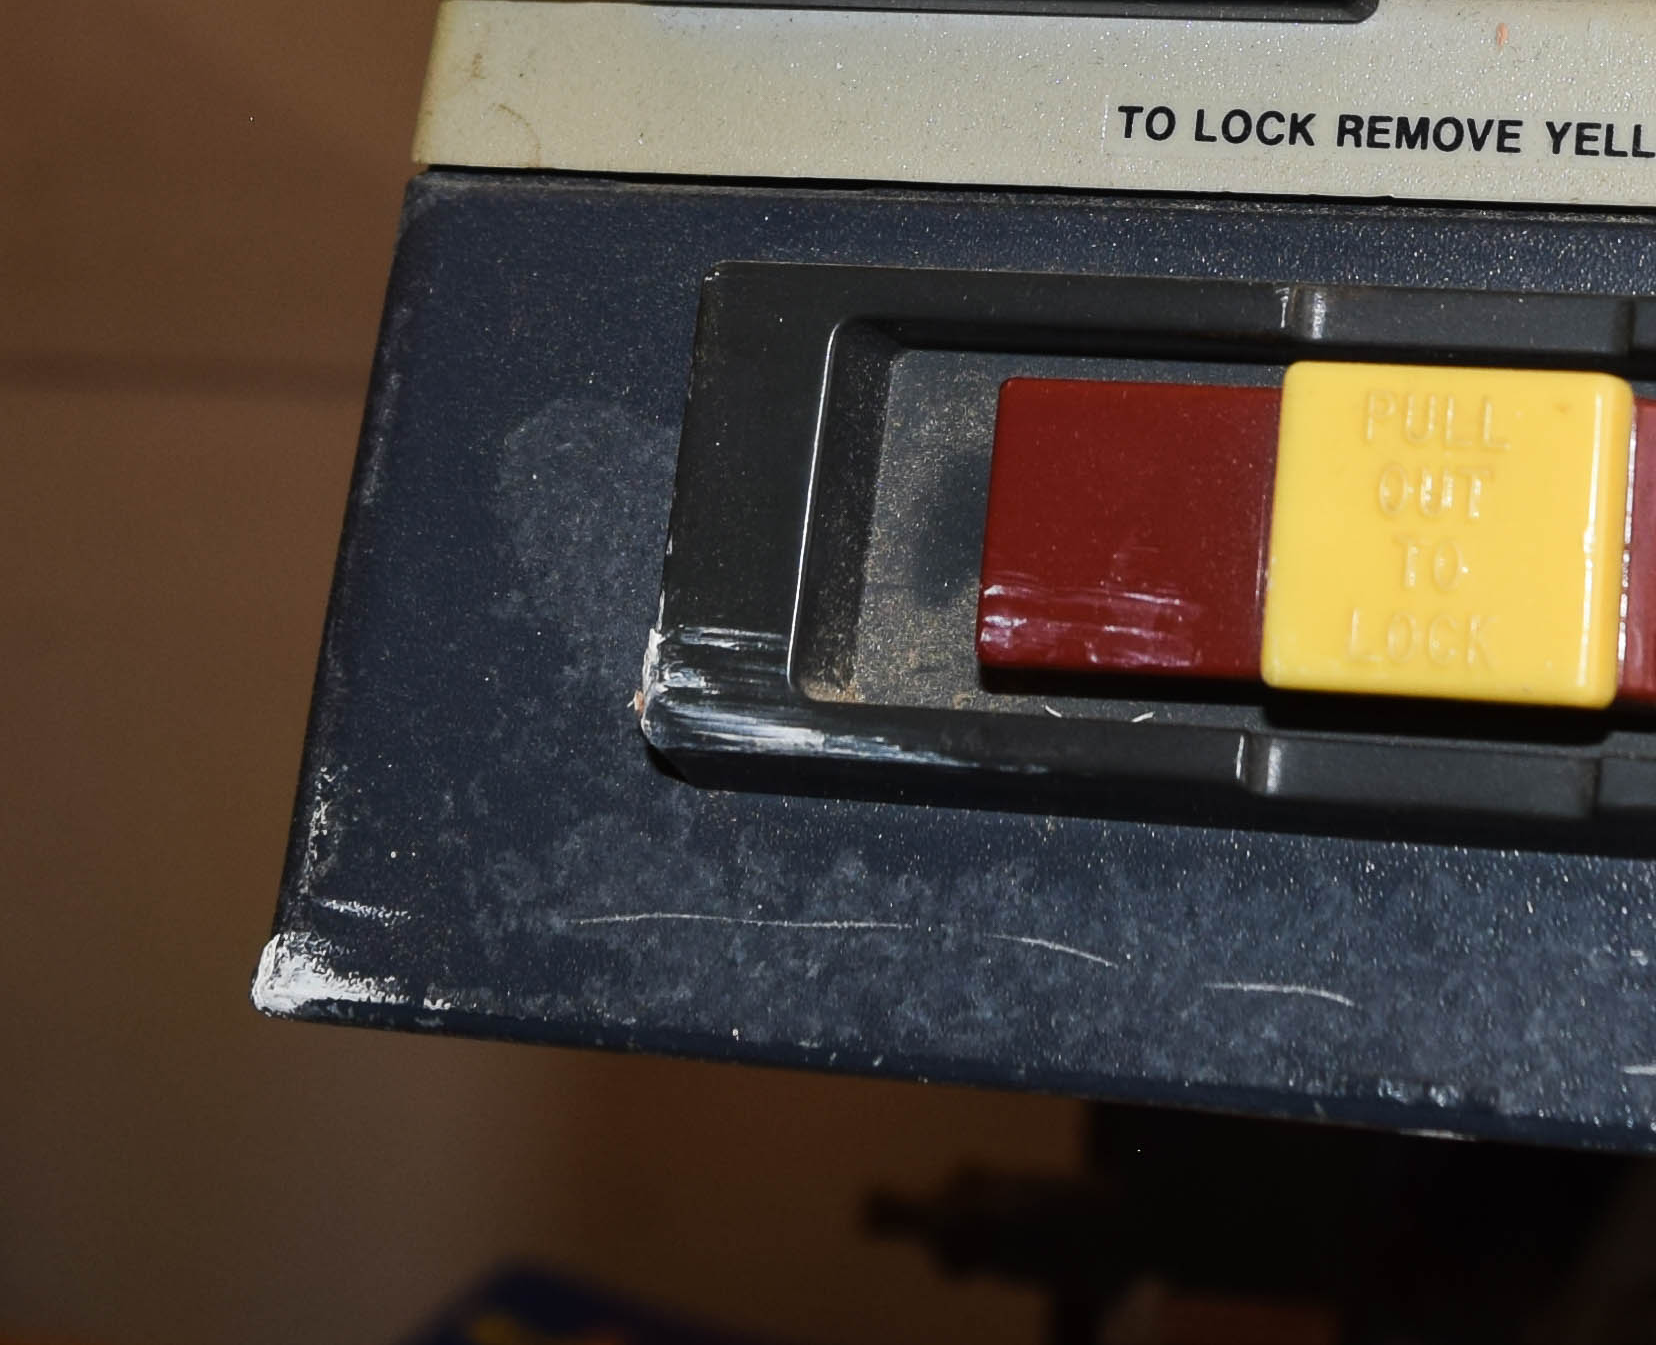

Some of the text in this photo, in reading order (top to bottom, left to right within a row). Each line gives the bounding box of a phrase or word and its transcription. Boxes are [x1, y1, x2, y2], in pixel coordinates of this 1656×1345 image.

[1117, 105, 1176, 142] TO
[1195, 108, 1318, 147] LOCK
[1335, 114, 1523, 154] REMOVE
[1363, 388, 1513, 452] PULL
[1377, 463, 1495, 520] OUT
[1392, 533, 1468, 593] TO
[1346, 606, 1500, 666] LOCK
